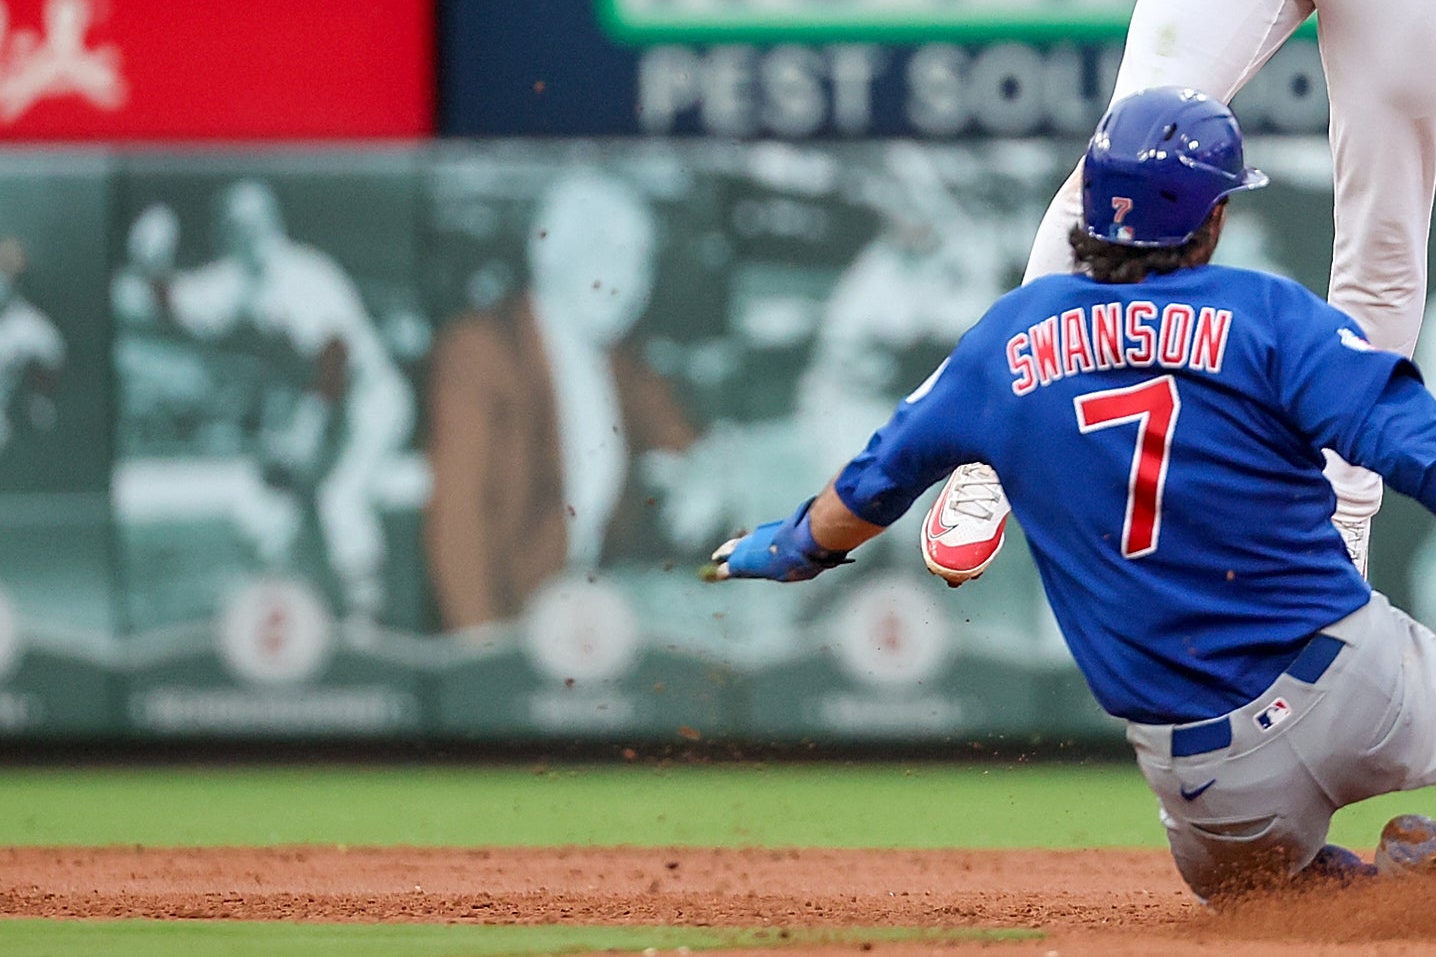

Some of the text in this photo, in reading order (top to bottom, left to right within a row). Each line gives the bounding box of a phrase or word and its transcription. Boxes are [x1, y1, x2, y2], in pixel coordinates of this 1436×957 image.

[638, 42, 886, 133] PEST
[1111, 196, 1134, 224] 7
[1005, 300, 1233, 397] SWANSON
[1073, 374, 1182, 560] 7
